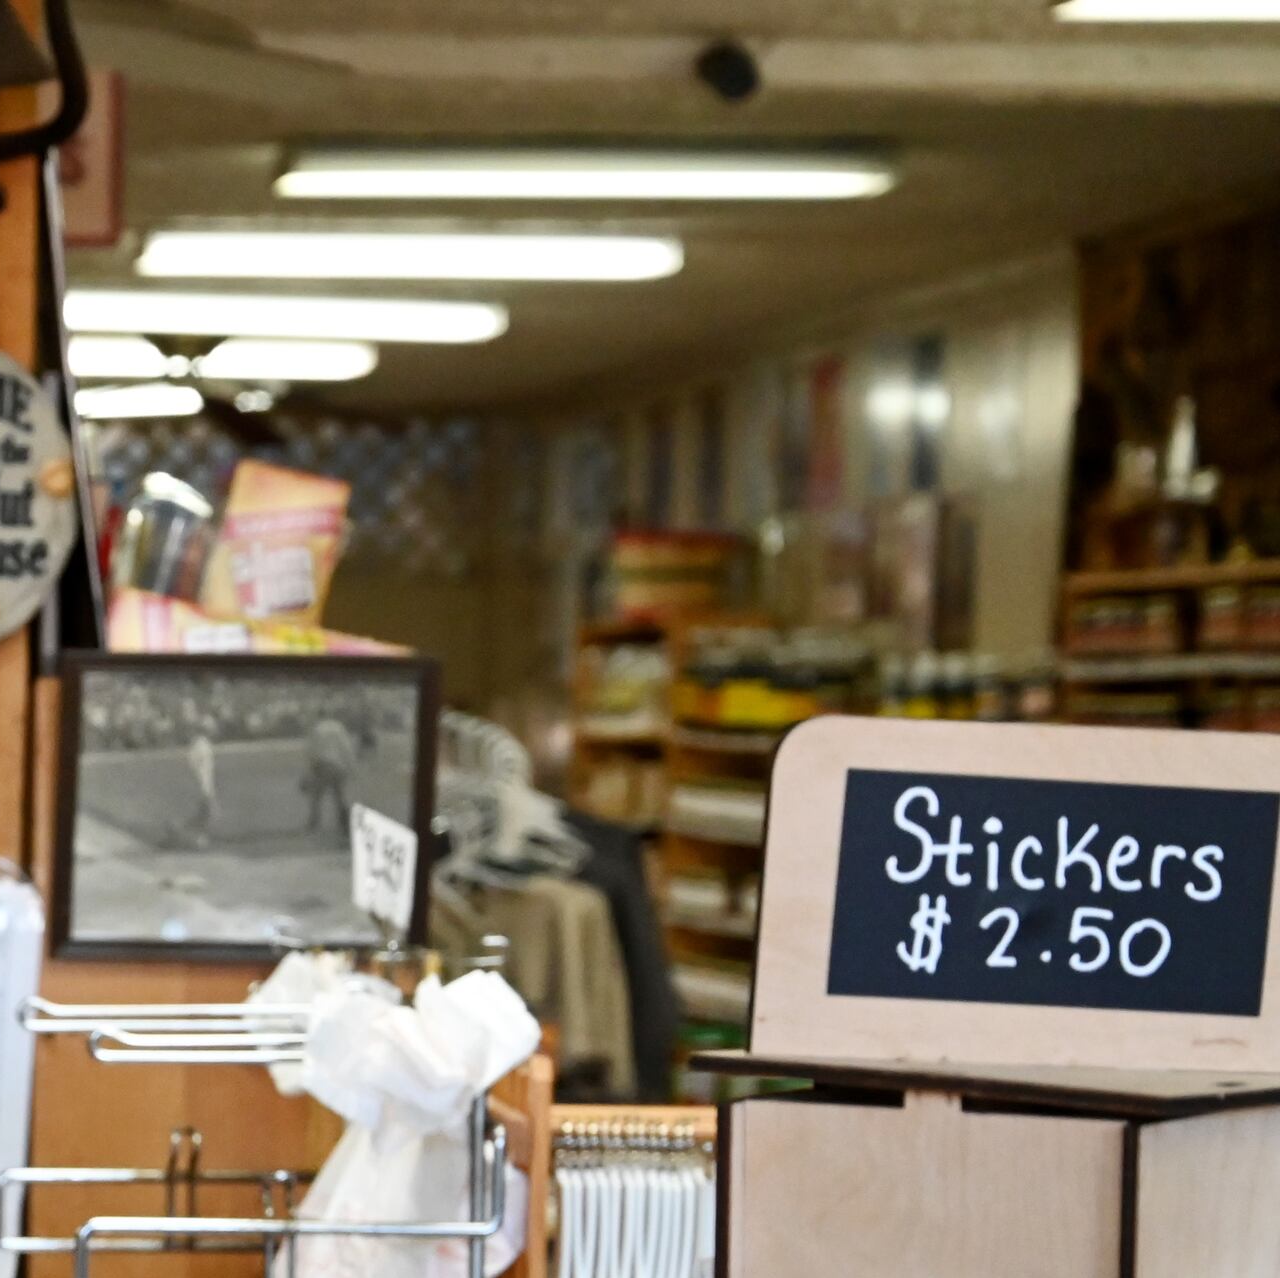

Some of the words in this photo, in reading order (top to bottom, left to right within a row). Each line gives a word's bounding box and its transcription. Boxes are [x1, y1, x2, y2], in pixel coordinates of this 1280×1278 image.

[0, 434, 30, 463] the
[885, 786, 1225, 901] Stickers
[978, 906, 1173, 977] 2.50
